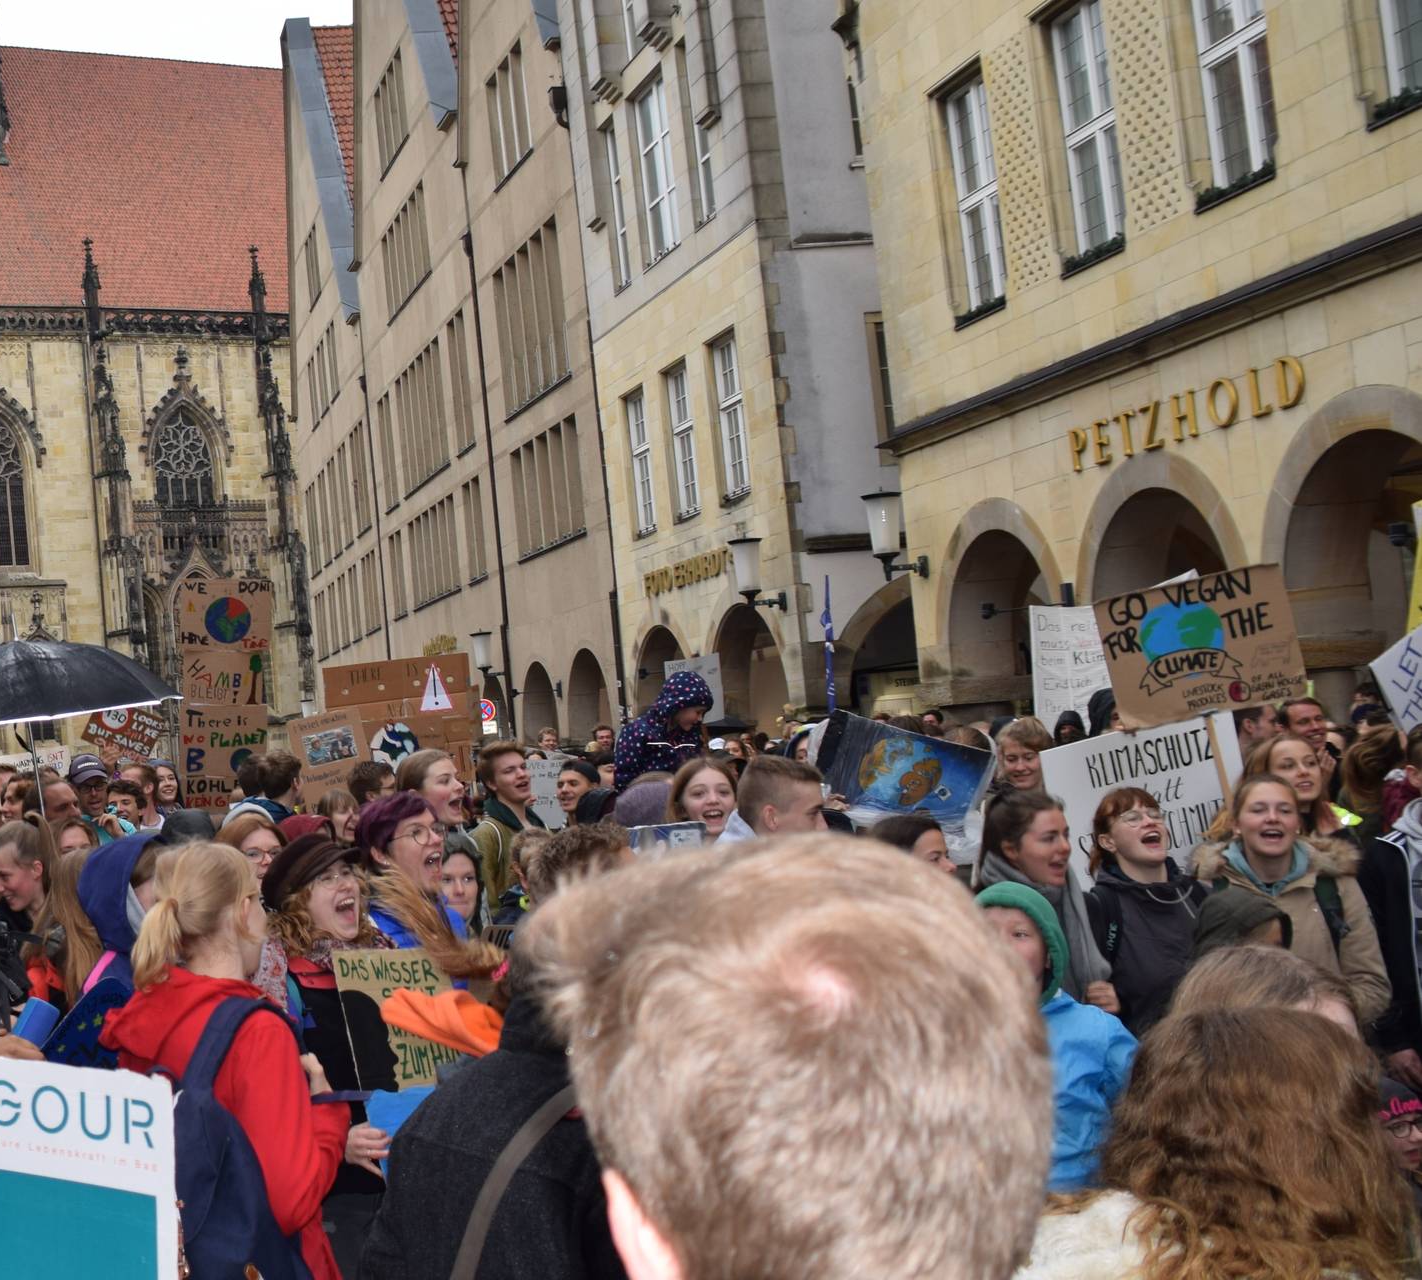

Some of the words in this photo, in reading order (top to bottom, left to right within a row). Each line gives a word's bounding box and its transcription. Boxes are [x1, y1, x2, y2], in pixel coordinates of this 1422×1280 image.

[1068, 356, 1306, 472] PETZHOLD
[185, 582, 208, 595] WE
[643, 567, 673, 598] FOTO
[1108, 593, 1148, 626] GO
[1161, 568, 1251, 608] VEGAN
[1103, 626, 1143, 660] FOR
[1221, 602, 1273, 639] THE
[1154, 651, 1219, 679] CLIMATE
[186, 710, 232, 728] There
[210, 728, 268, 748] PLANET
[186, 748, 206, 773] B
[1086, 726, 1215, 789] KLIMASCHUTZ
[338, 957, 370, 981] DAS
[370, 955, 440, 984] WASSER
[396, 1043, 432, 1080] ZUM
[28, 1142, 106, 1162] Lebenskraft
